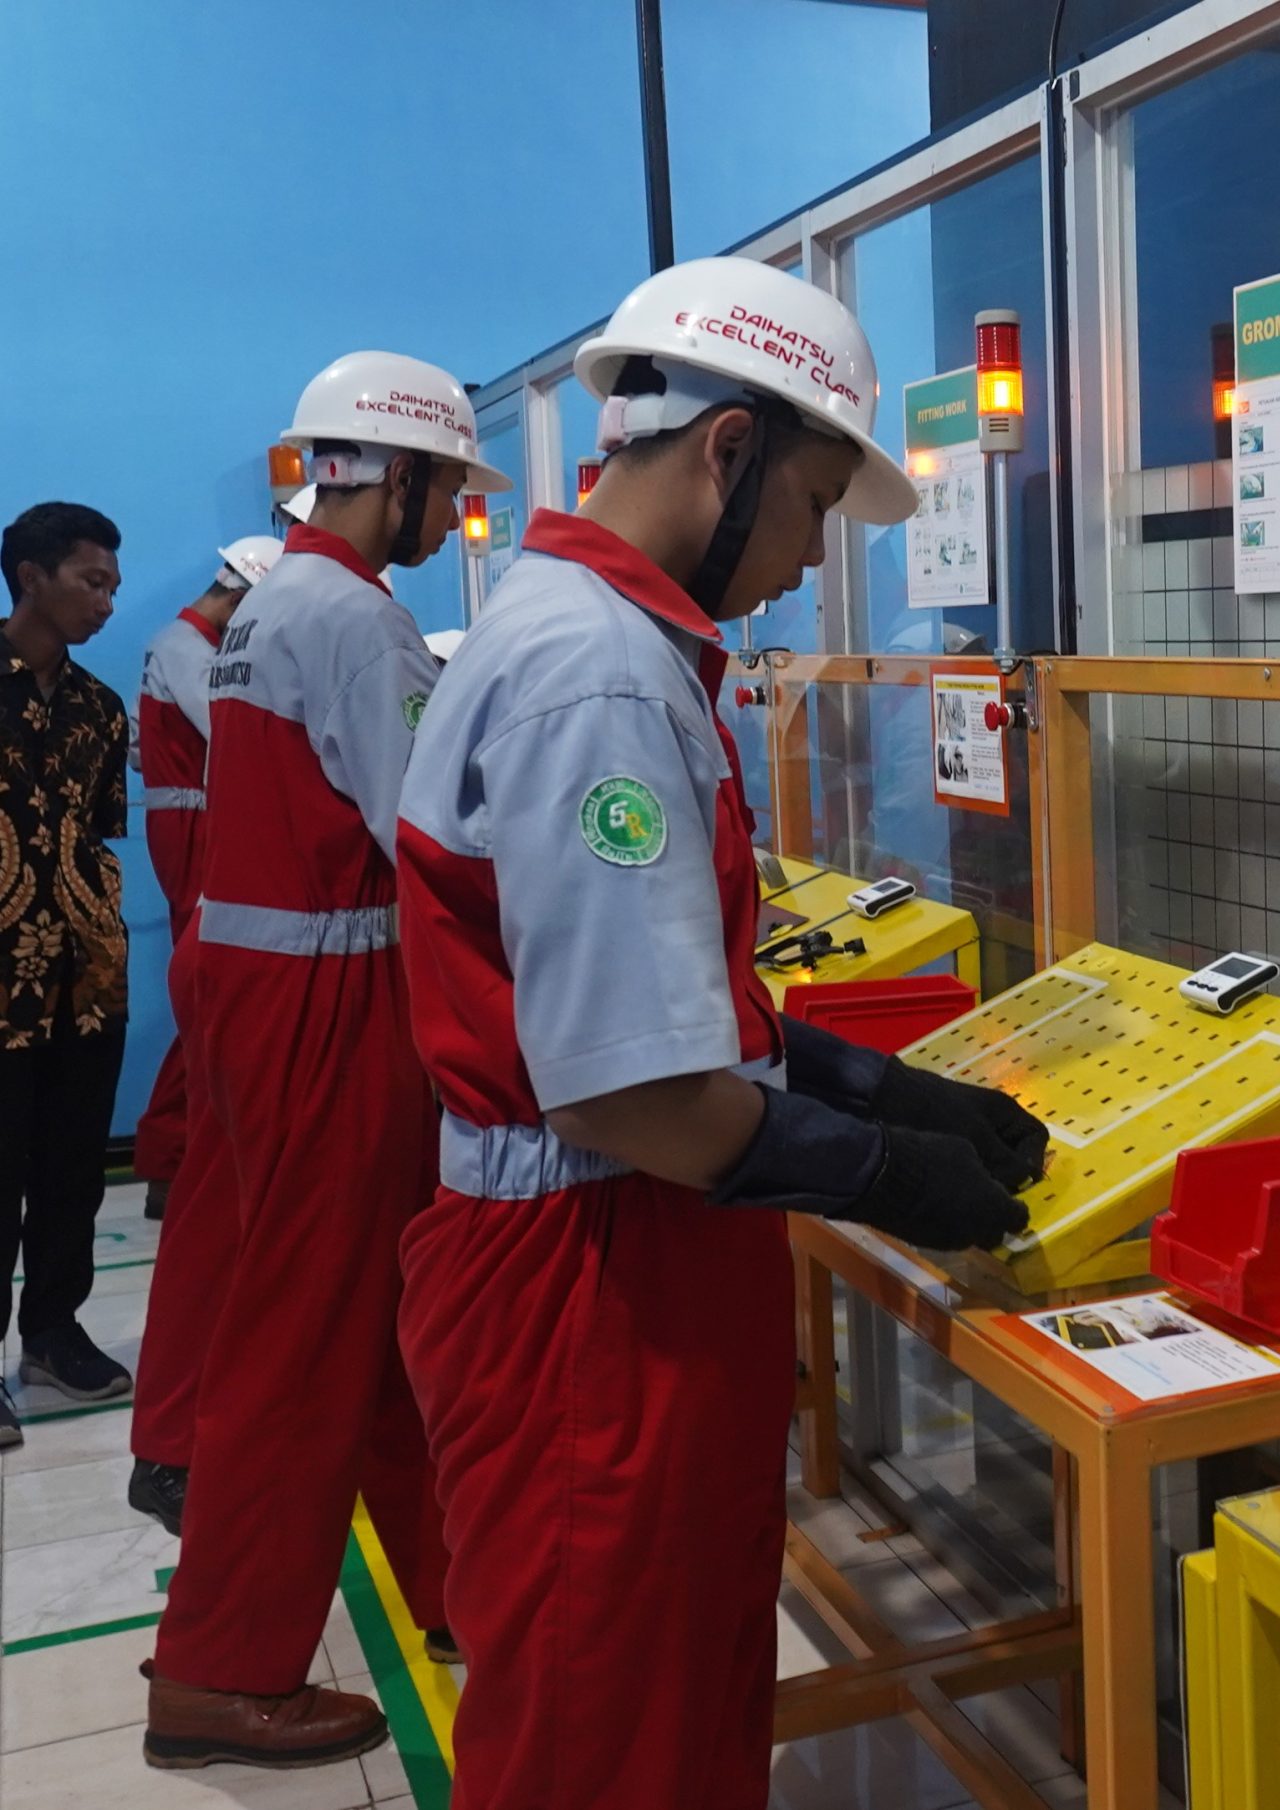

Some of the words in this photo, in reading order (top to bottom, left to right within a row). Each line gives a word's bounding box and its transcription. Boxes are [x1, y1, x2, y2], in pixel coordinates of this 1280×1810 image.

[730, 305, 834, 367] DAIHATSU
[356, 400, 441, 424] EXCELLENT
[444, 417, 473, 440] CLASS
[389, 390, 455, 417] DAIHATSU
[917, 405, 945, 424] FITTING
[945, 399, 967, 417] WORK
